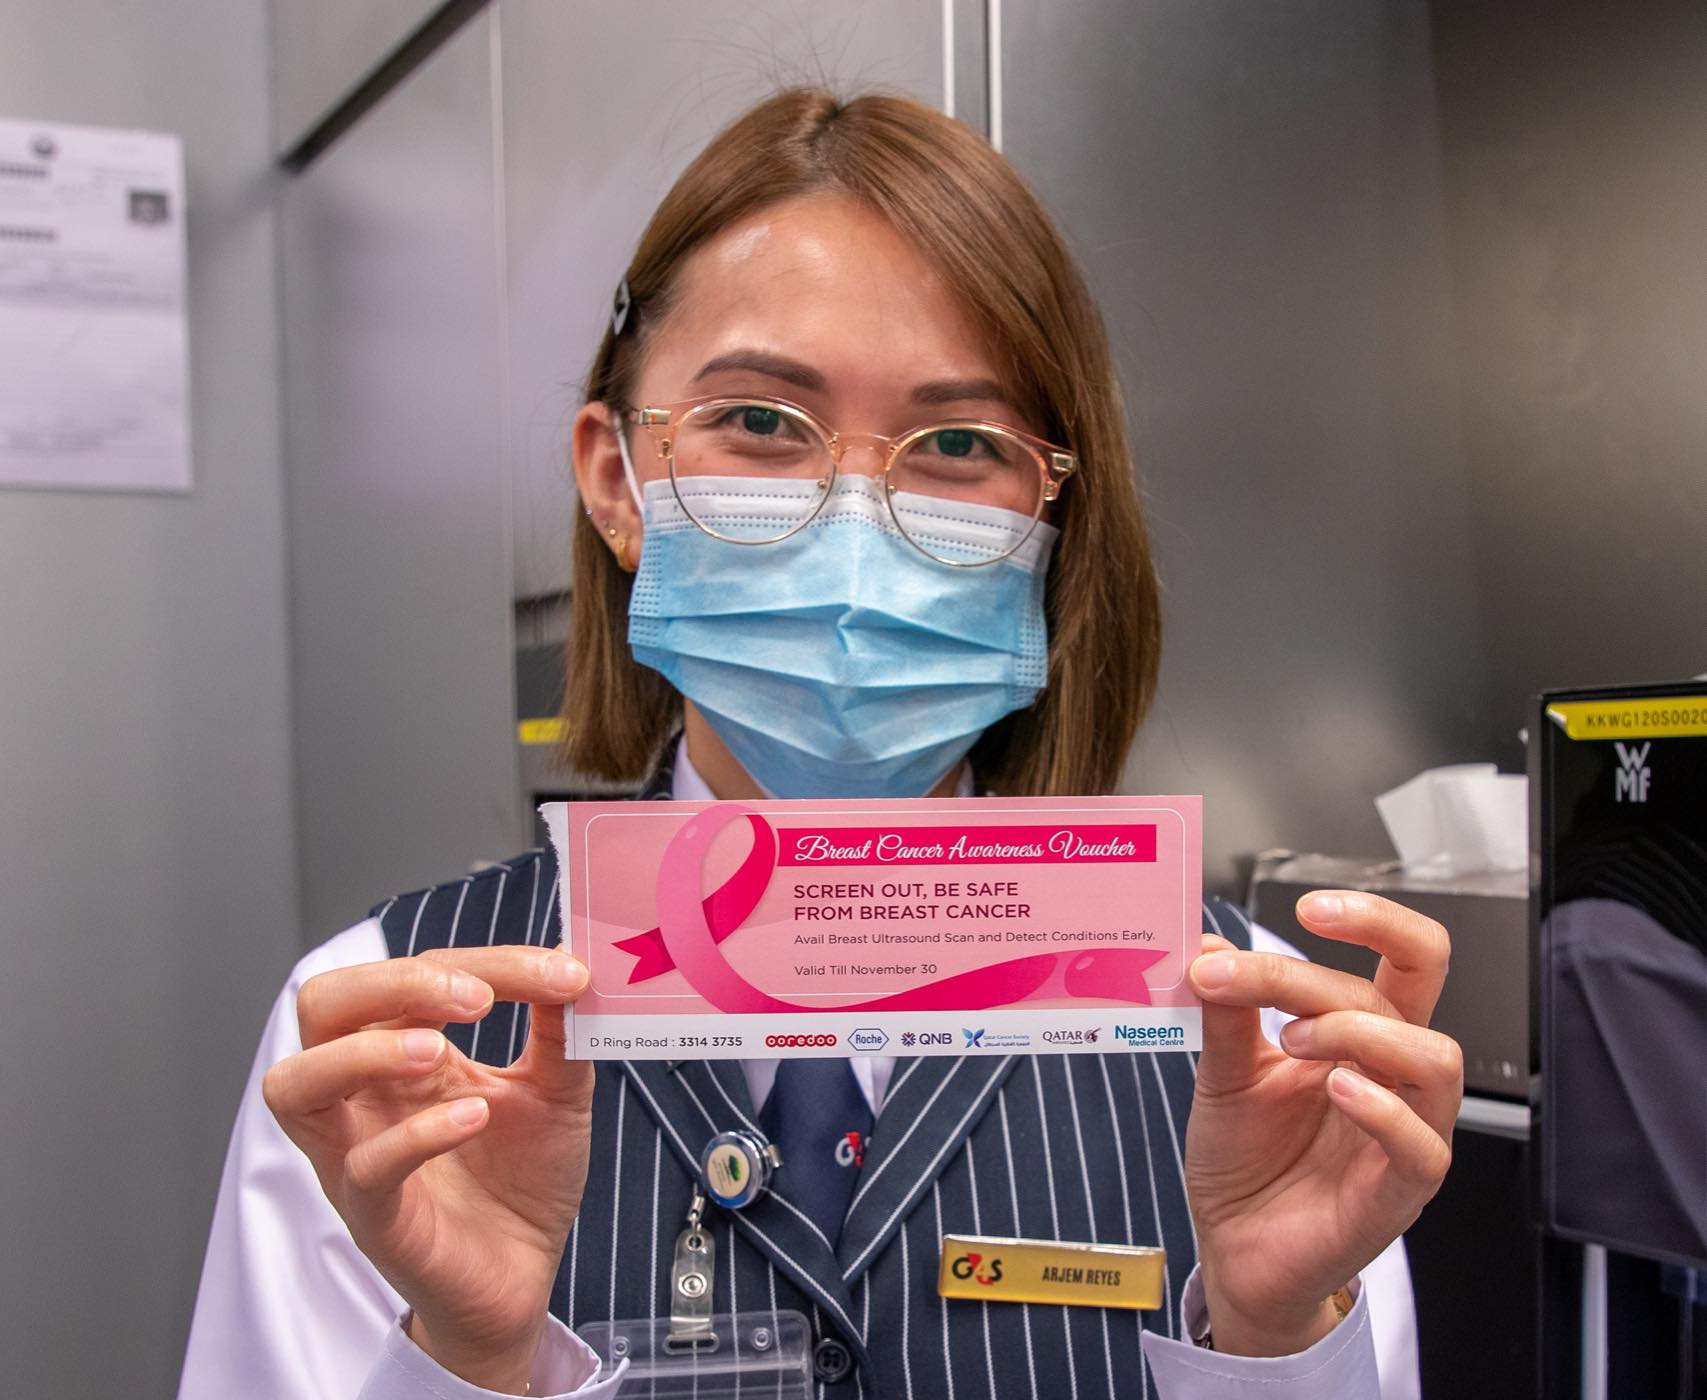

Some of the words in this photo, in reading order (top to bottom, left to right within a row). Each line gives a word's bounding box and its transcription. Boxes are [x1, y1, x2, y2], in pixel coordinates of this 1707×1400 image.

[794, 835, 872, 861] Breast
[876, 834, 945, 862] Cancer
[948, 835, 1044, 860] Awareness
[1049, 830, 1136, 859] Voucher
[794, 884, 874, 898] SCREEN
[881, 883, 928, 900] OUT,
[934, 883, 960, 897] BE
[967, 882, 1018, 897] SAFE
[794, 906, 853, 920] FROM
[860, 905, 939, 919] BREAST
[946, 904, 1031, 919] CANCER
[794, 934, 824, 945] Avail
[828, 934, 868, 944] Breast
[872, 933, 941, 944] Ultrasound
[944, 933, 975, 943] Scan
[978, 932, 1002, 942] and
[1006, 931, 1047, 942] Detect
[1051, 930, 1118, 941] Conditions
[1122, 930, 1156, 942] Early.
[794, 965, 825, 976] Valid
[829, 964, 847, 975] Till
[851, 964, 916, 975] November
[921, 963, 937, 974] 30
[855, 1034, 882, 1044] Roche
[919, 1033, 952, 1045] QNB
[1042, 1030, 1083, 1043] QATAR
[1115, 1025, 1184, 1040] Naseem
[590, 1037, 600, 1047] D
[603, 1037, 632, 1049] Ring
[635, 1037, 668, 1047] Road
[679, 1037, 708, 1047] 3314
[712, 1036, 743, 1047] 3735
[766, 1034, 837, 1048] ooredoo
[1129, 1039, 1157, 1047] Medical
[1159, 1039, 1184, 1047] Centre
[1042, 1266, 1083, 1284] ARJEM
[1086, 1268, 1121, 1287] REYES
